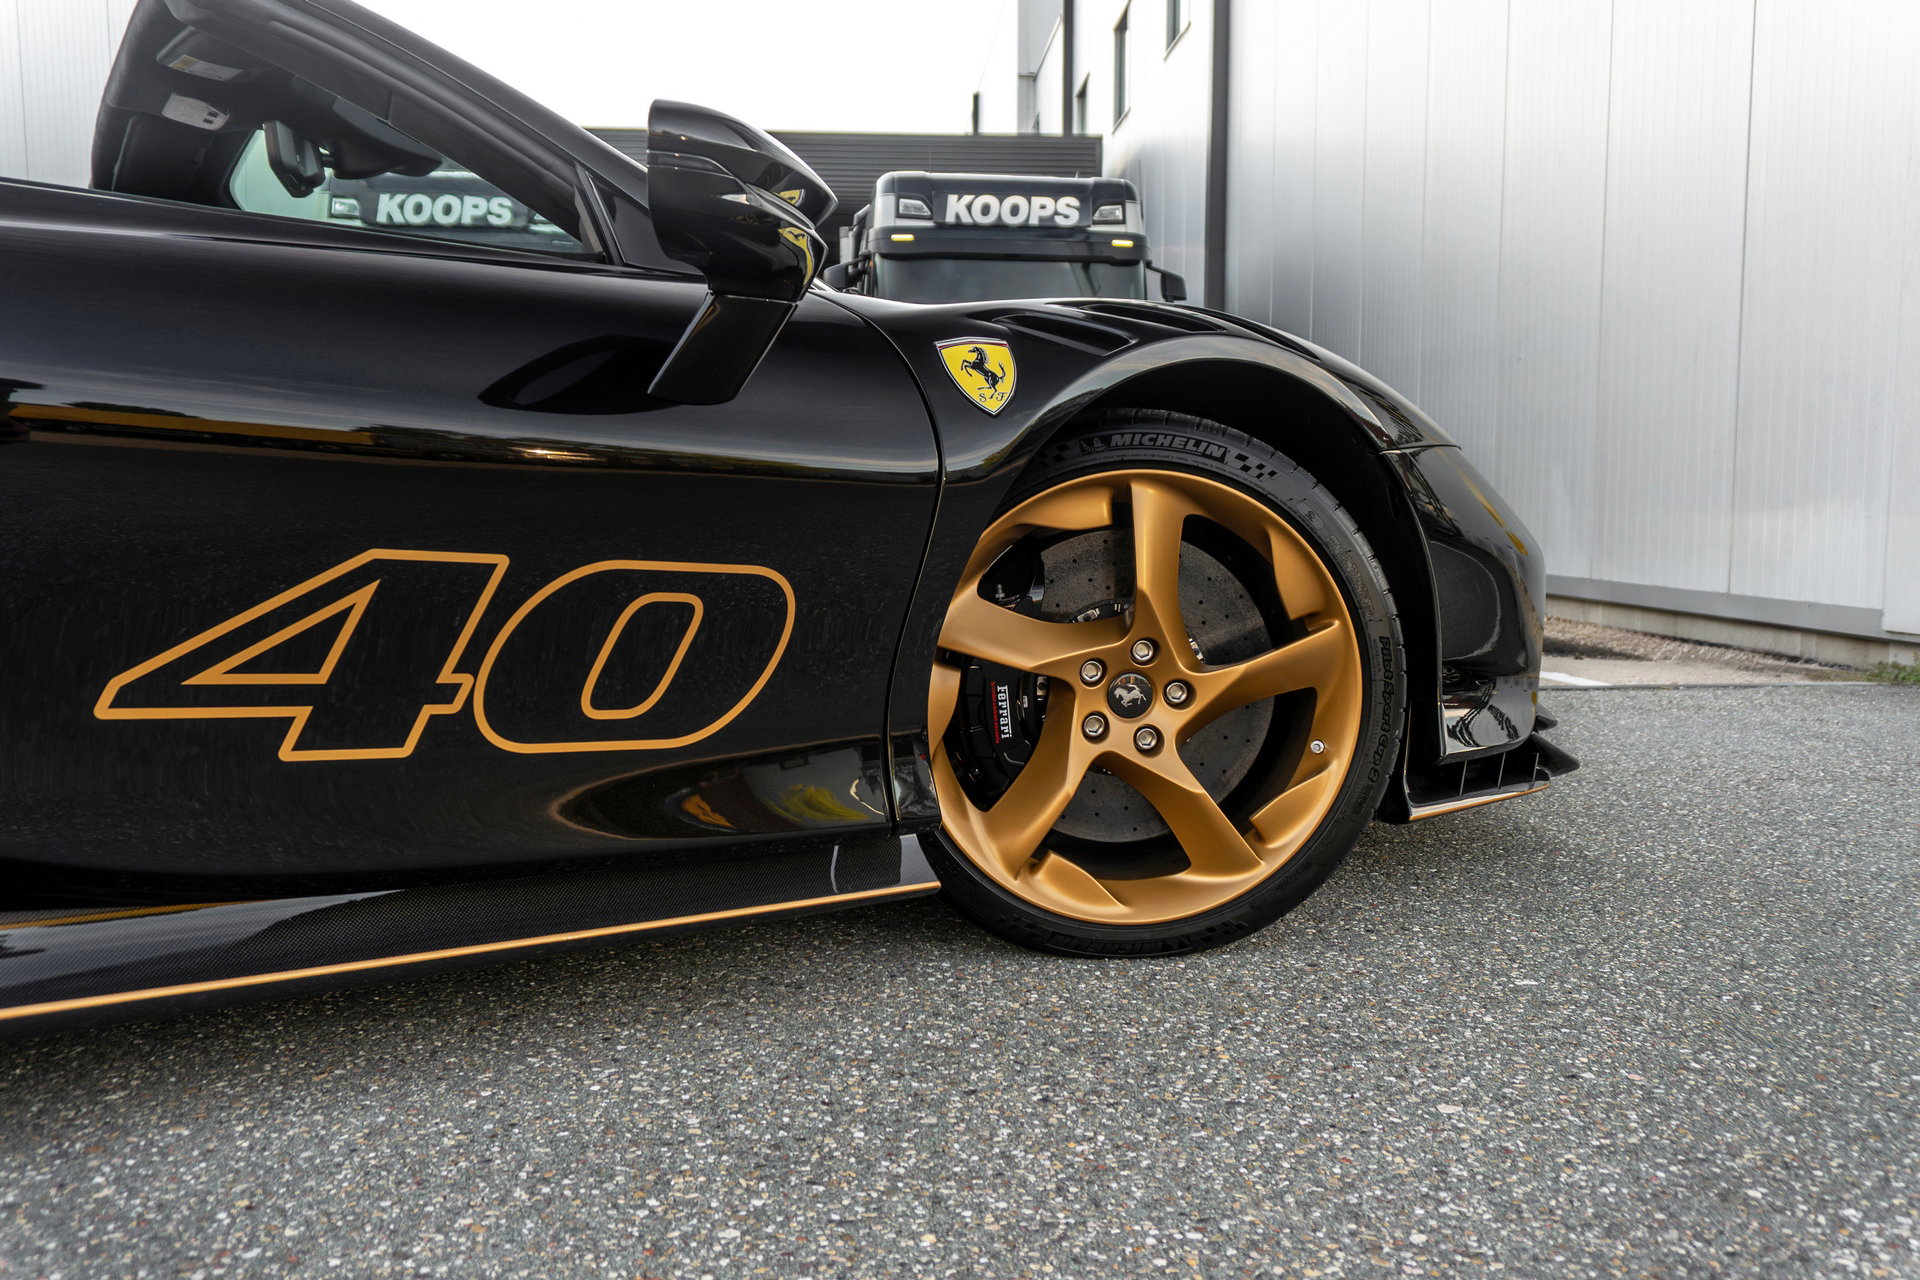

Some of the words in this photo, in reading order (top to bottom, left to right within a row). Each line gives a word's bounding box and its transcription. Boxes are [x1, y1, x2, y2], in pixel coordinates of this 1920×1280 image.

[376, 193, 513, 226] KOOPS
[944, 194, 1081, 227] KOOPS
[1110, 433, 1228, 459] MICHELIN
[94, 548, 796, 762] 40
[1378, 636, 1394, 681] Pilot
[996, 684, 1013, 739] Ferrari
[1380, 679, 1395, 734] Sport
[1372, 733, 1389, 767] Cup
[1367, 766, 1380, 784] 2
